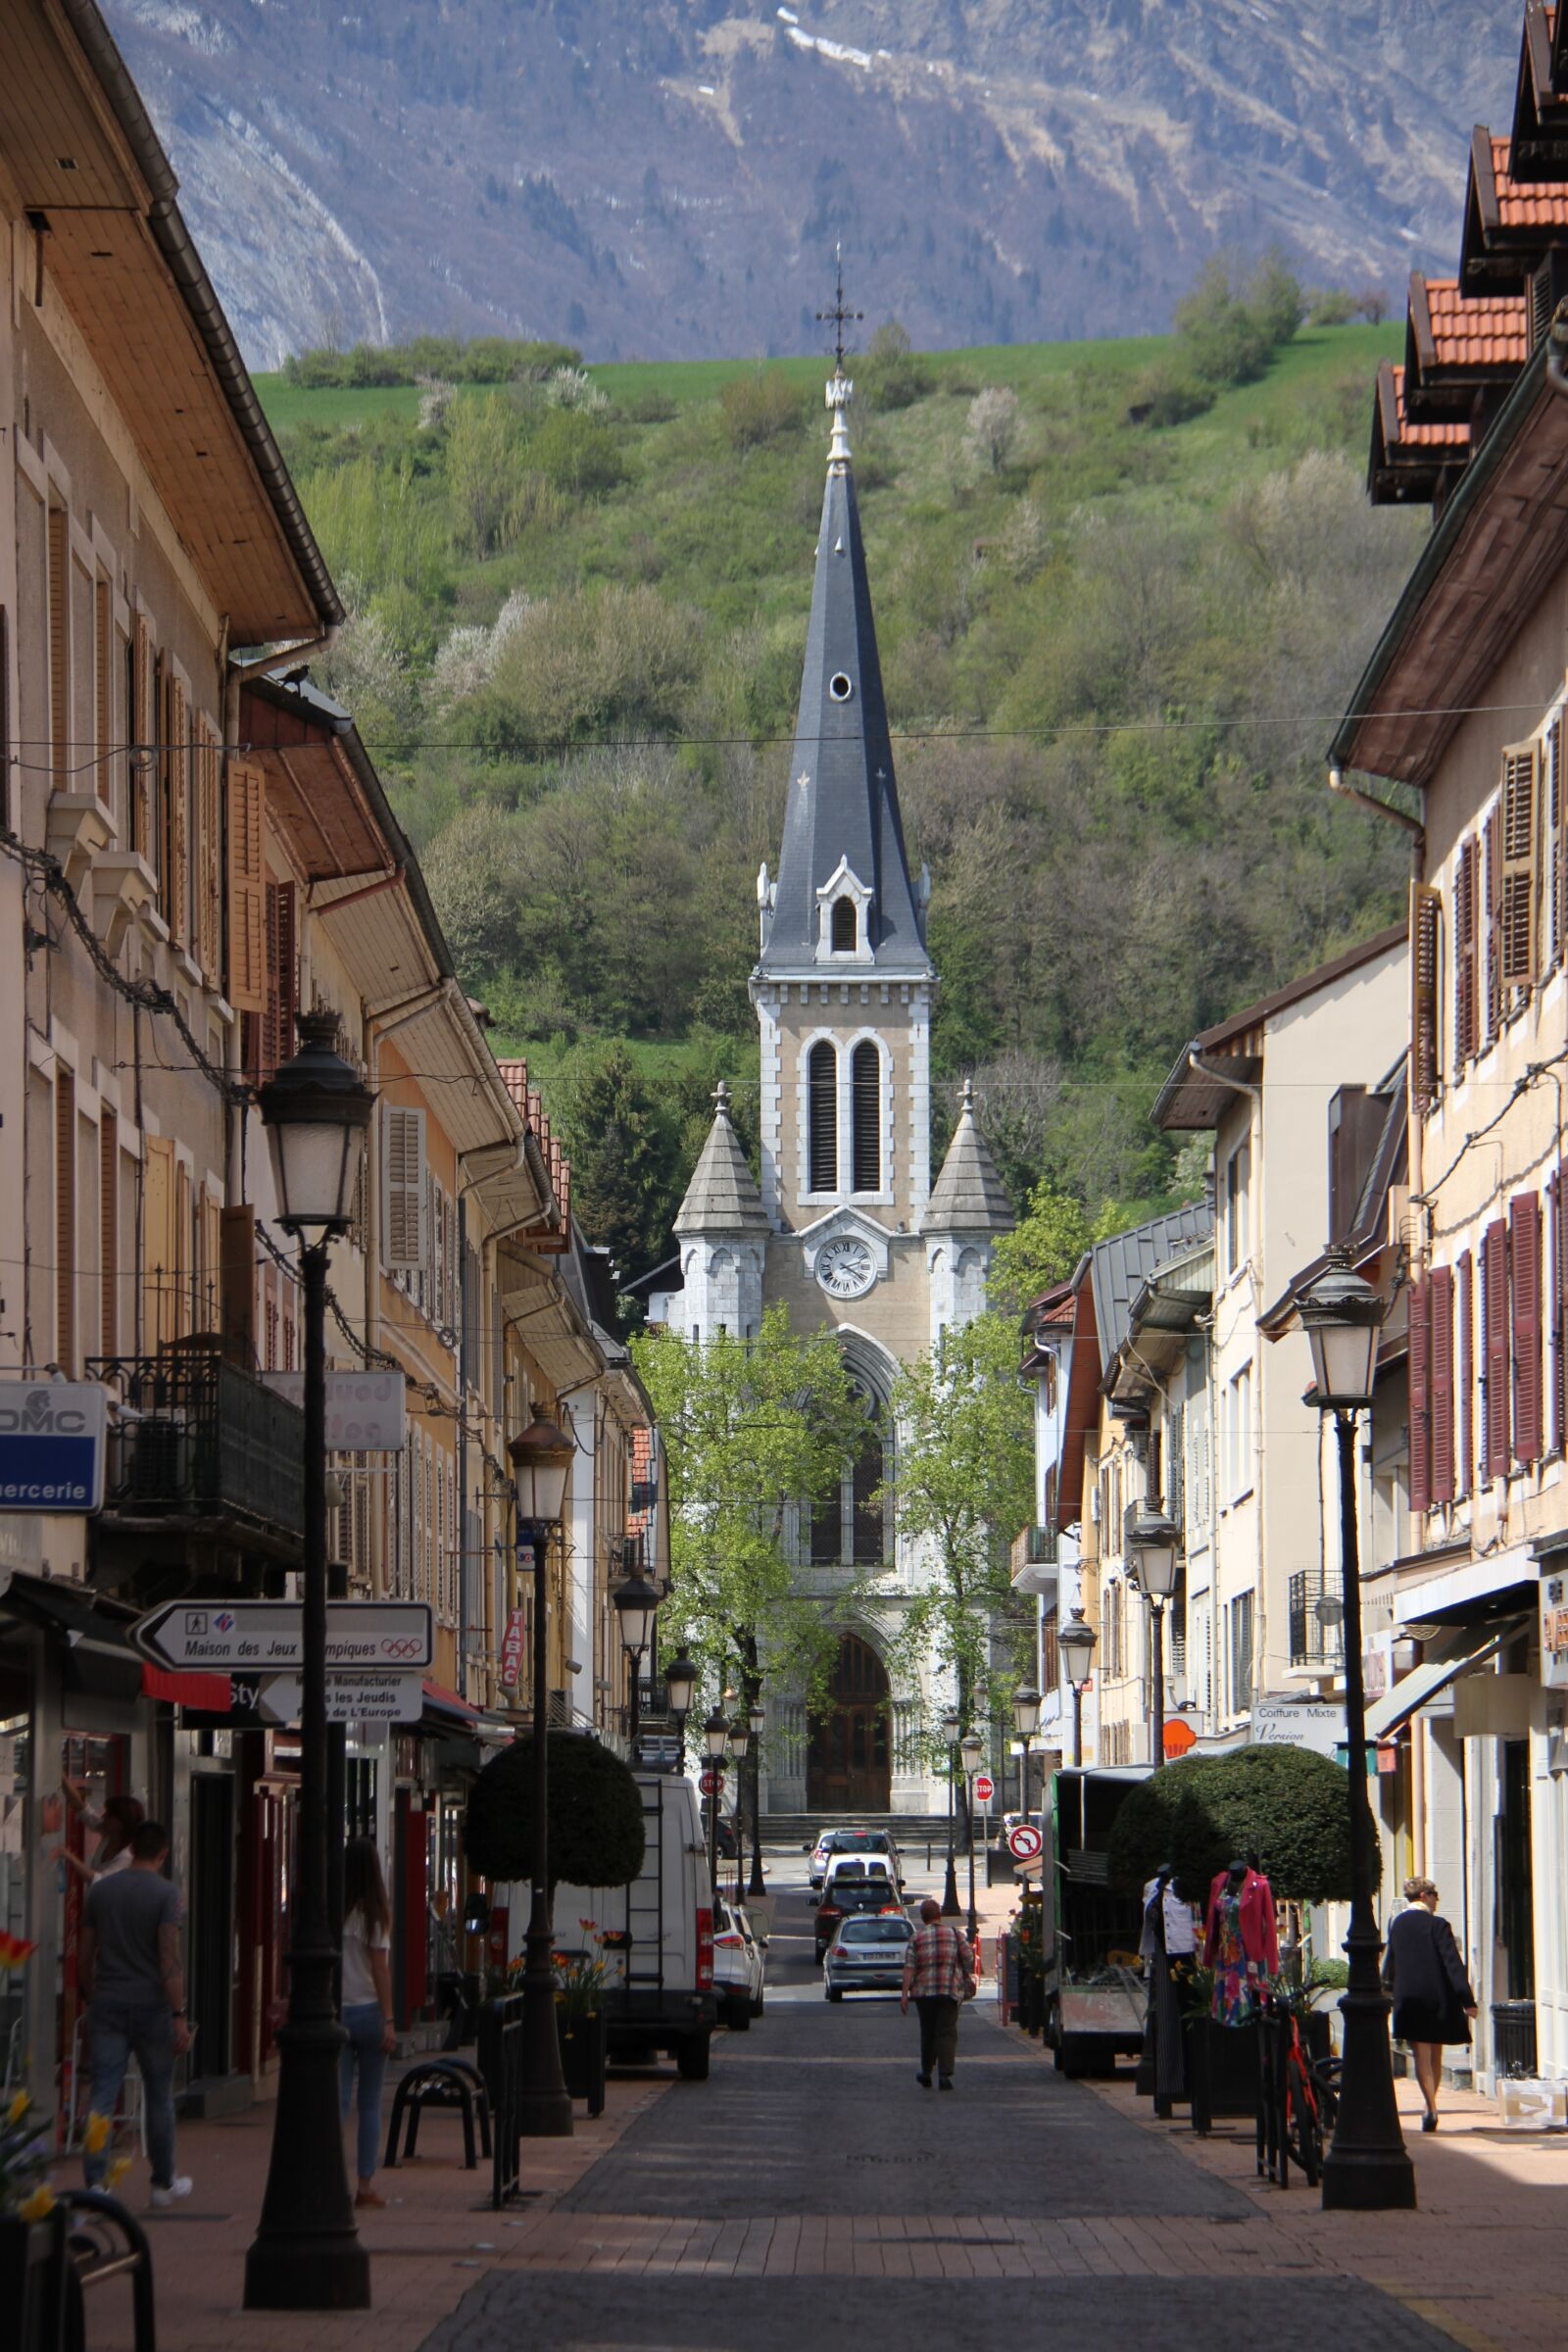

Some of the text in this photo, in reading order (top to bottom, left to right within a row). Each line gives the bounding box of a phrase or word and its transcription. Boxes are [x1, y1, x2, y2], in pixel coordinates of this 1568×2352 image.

[0, 1409, 86, 1433] DMC
[0, 1481, 86, 1499] ercerie
[185, 1640, 376, 1659] Maison des Jeux mpiques
[504, 1611, 521, 1684] TABAC
[334, 1674, 402, 1687] Manufacturier
[335, 1691, 353, 1703] les
[357, 1691, 396, 1703] Jeudis
[332, 1707, 347, 1717] de
[351, 1707, 401, 1719] L'Europe
[1259, 1708, 1337, 1718] Coiffure Mixte
[1255, 1723, 1304, 1740] Version
